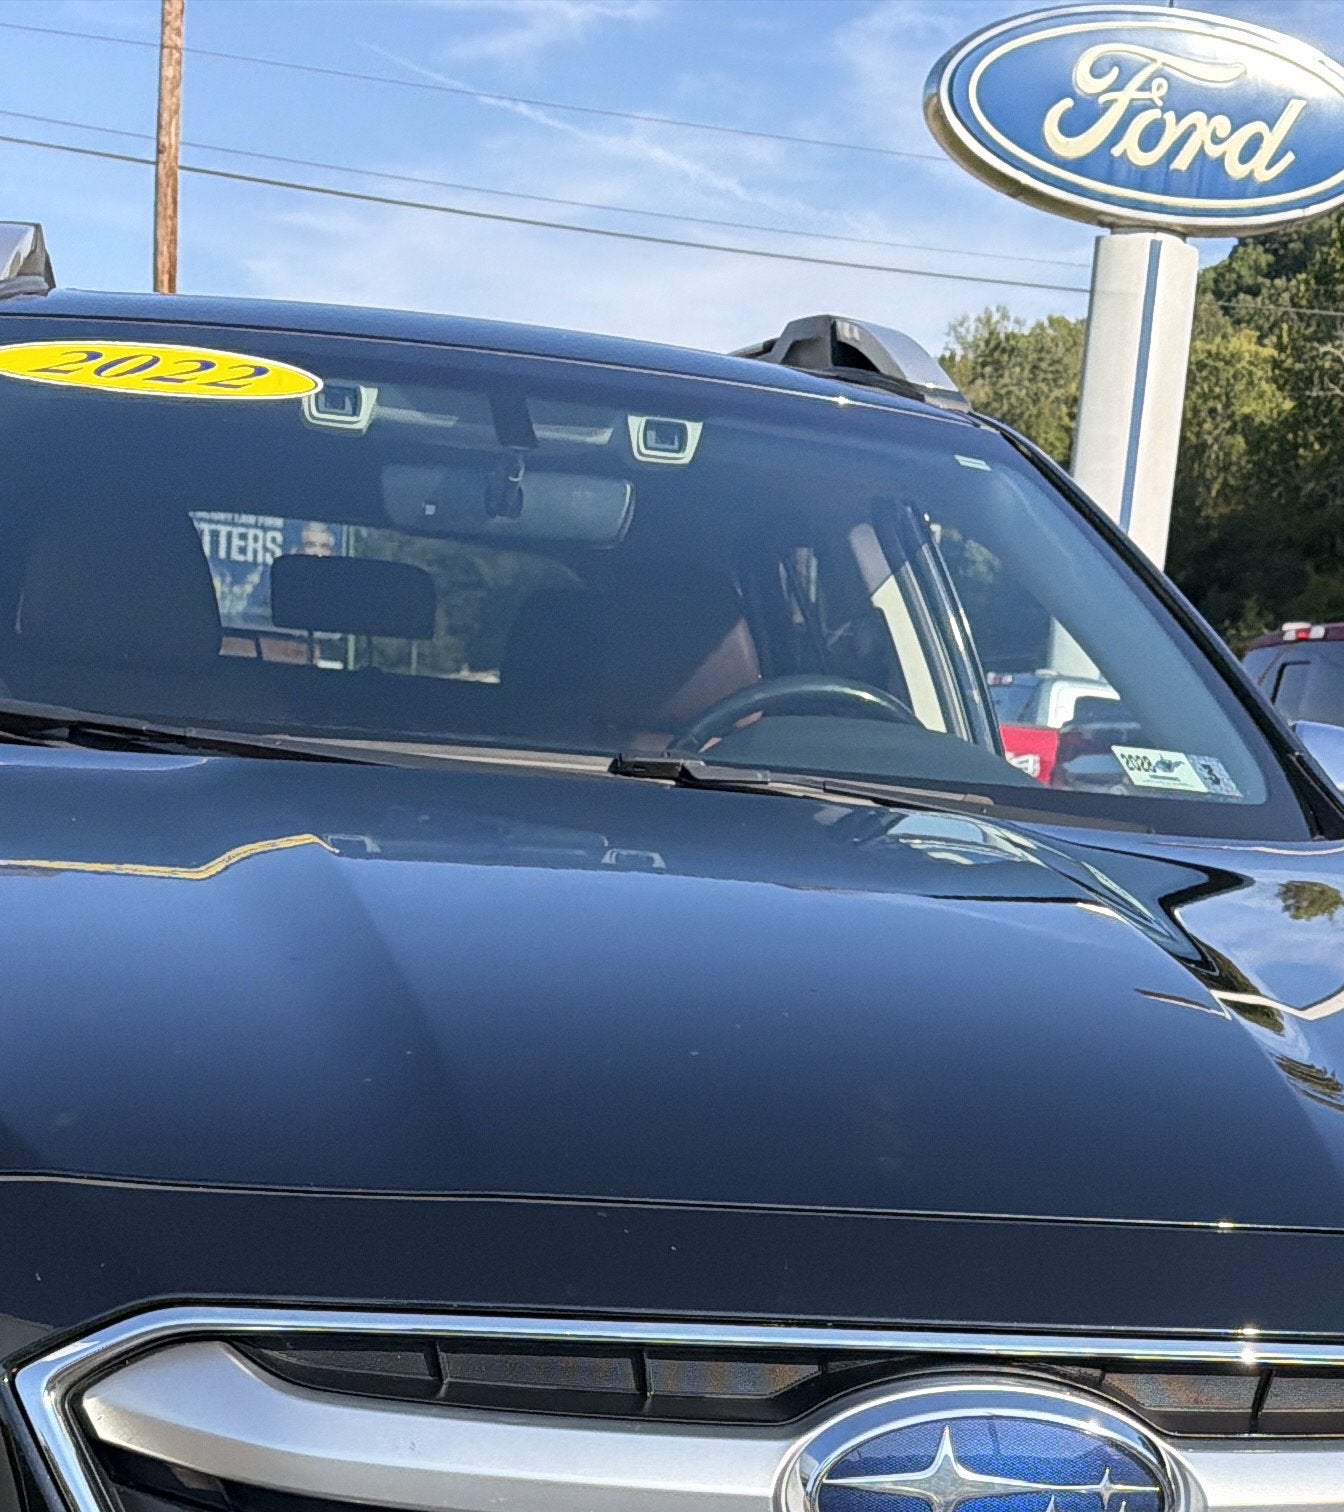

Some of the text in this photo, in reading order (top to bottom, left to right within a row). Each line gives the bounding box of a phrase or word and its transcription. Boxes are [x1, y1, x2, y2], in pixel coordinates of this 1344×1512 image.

[1043, 42, 1308, 183] Ford
[28, 350, 270, 389] 2022
[196, 521, 283, 567] TTERS
